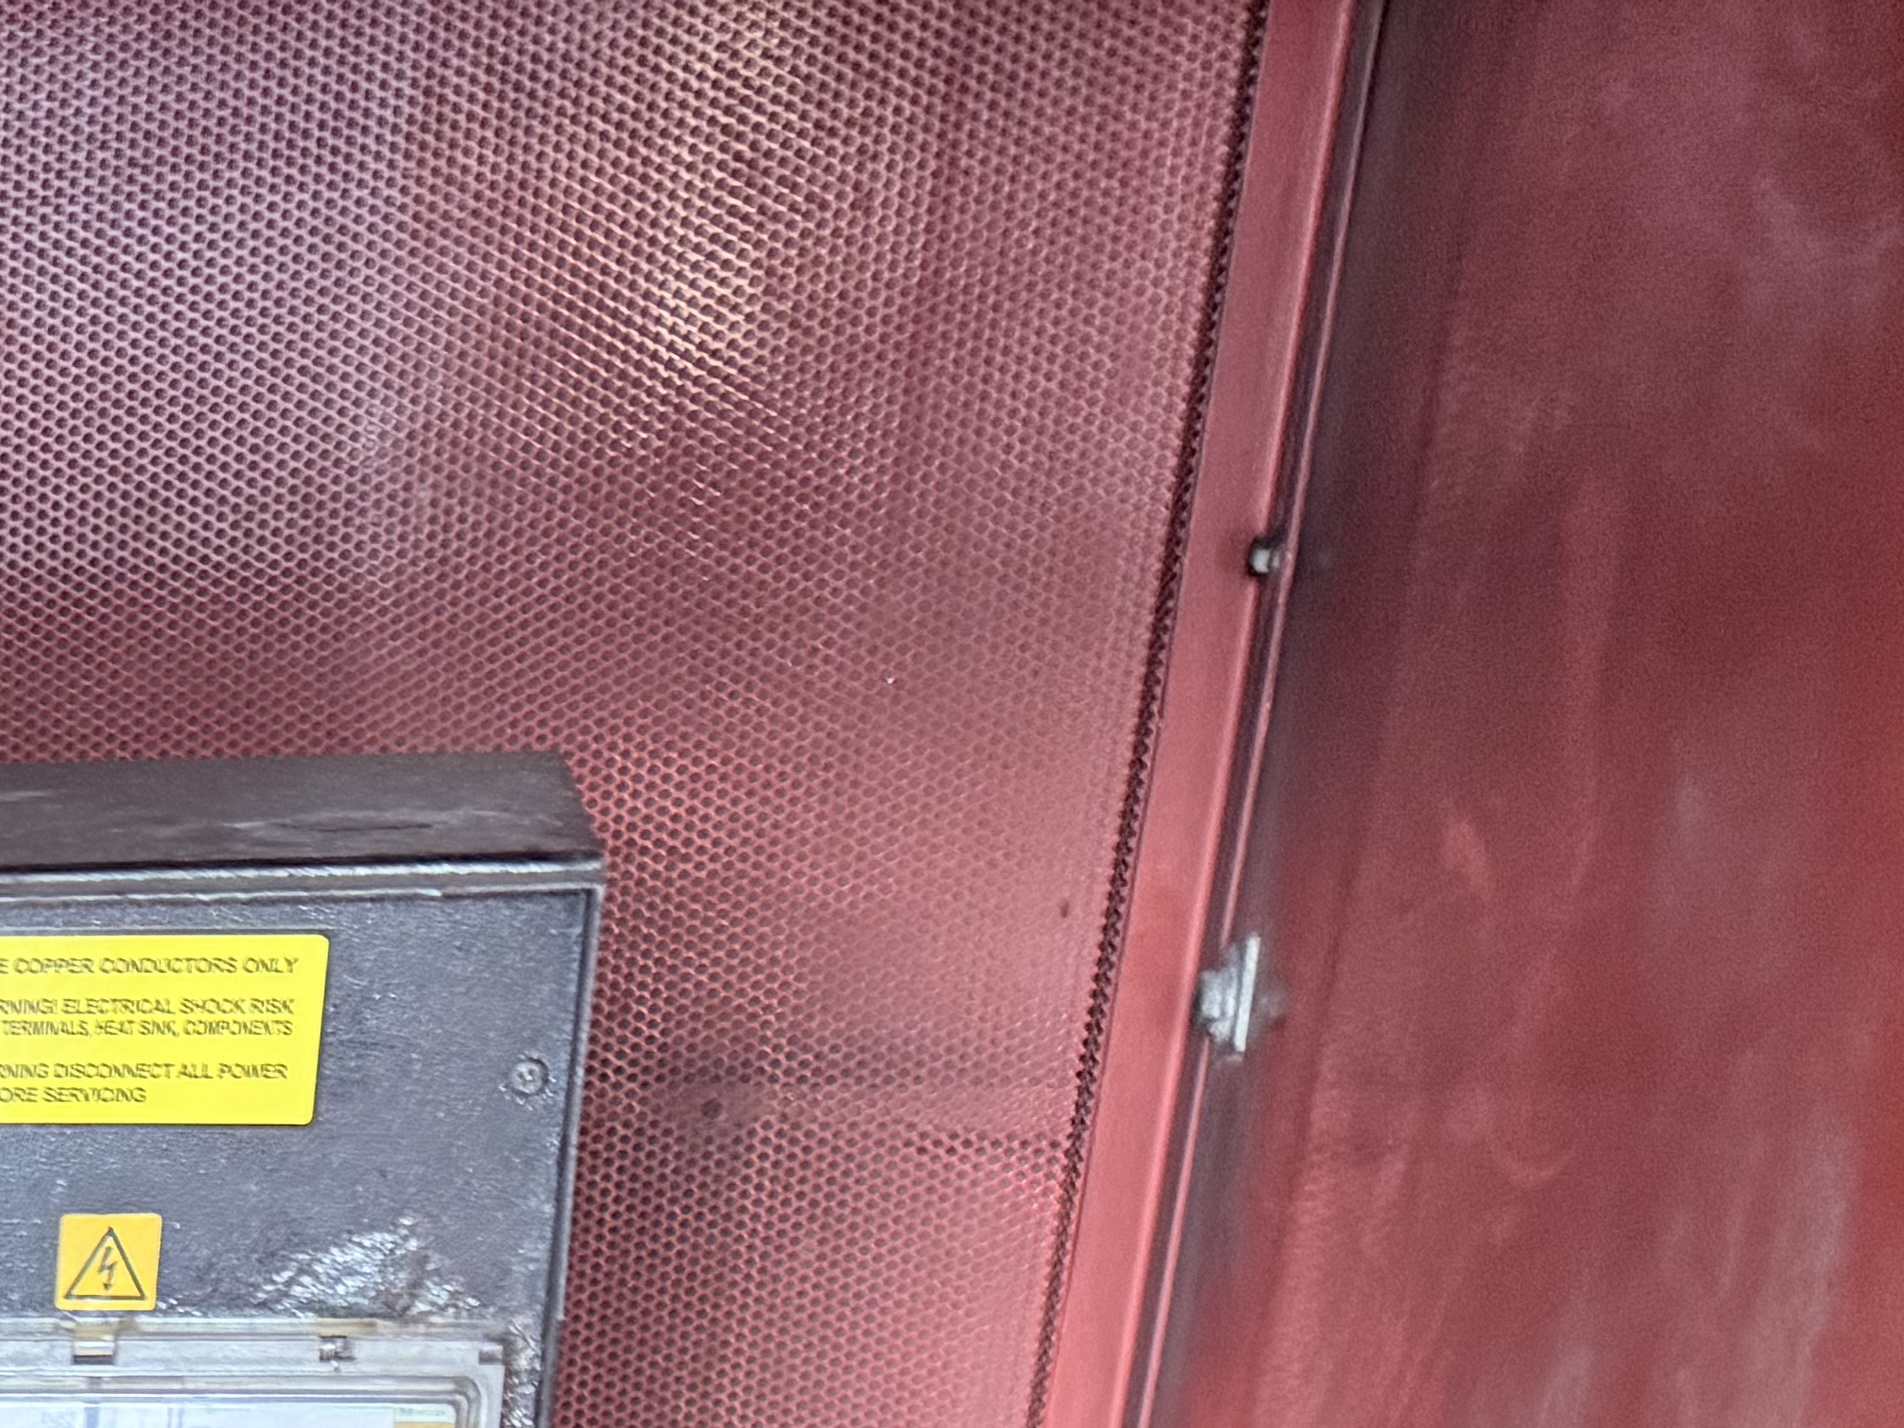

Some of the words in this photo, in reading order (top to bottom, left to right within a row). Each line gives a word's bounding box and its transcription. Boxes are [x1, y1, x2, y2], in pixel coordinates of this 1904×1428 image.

[13, 958, 94, 975] COPPER
[100, 957, 238, 975] CONDUCTORS
[242, 957, 299, 974] ONLY
[62, 999, 176, 1015] ELECTRICAL
[180, 998, 247, 1015] SHOCK
[251, 998, 294, 1014] RISK
[95, 1021, 136, 1036] HEAT
[184, 1021, 293, 1036] COMPONENTS
[54, 1063, 172, 1080] DISCONNECT
[178, 1063, 213, 1079] ALL
[218, 1063, 288, 1080] POWER
[42, 1087, 146, 1103] SERVICING
